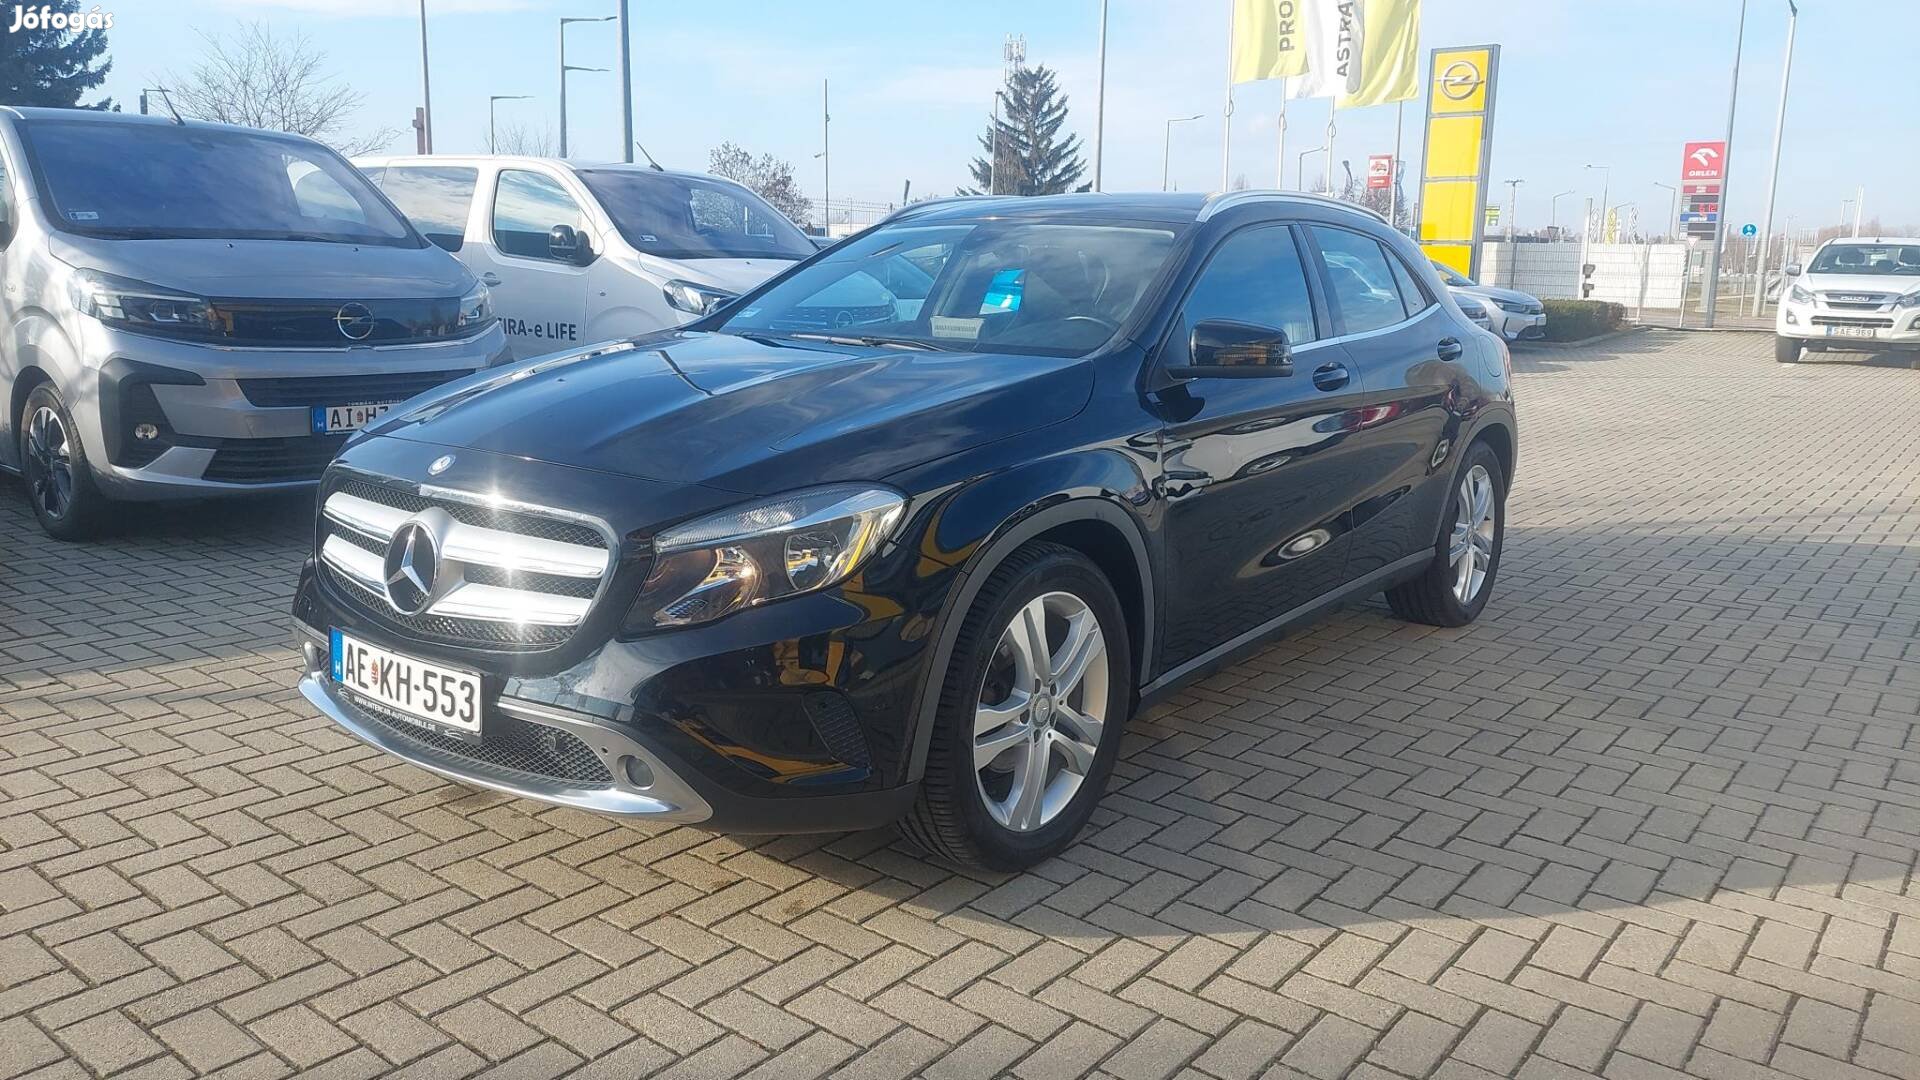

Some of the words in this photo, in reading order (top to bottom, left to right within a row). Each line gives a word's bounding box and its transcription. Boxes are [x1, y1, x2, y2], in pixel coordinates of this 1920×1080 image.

[1336, 1, 1354, 77] ASTRA
[547, 322, 577, 341] LIFE
[334, 661, 342, 675] H
[379, 656, 475, 723] KH-553
